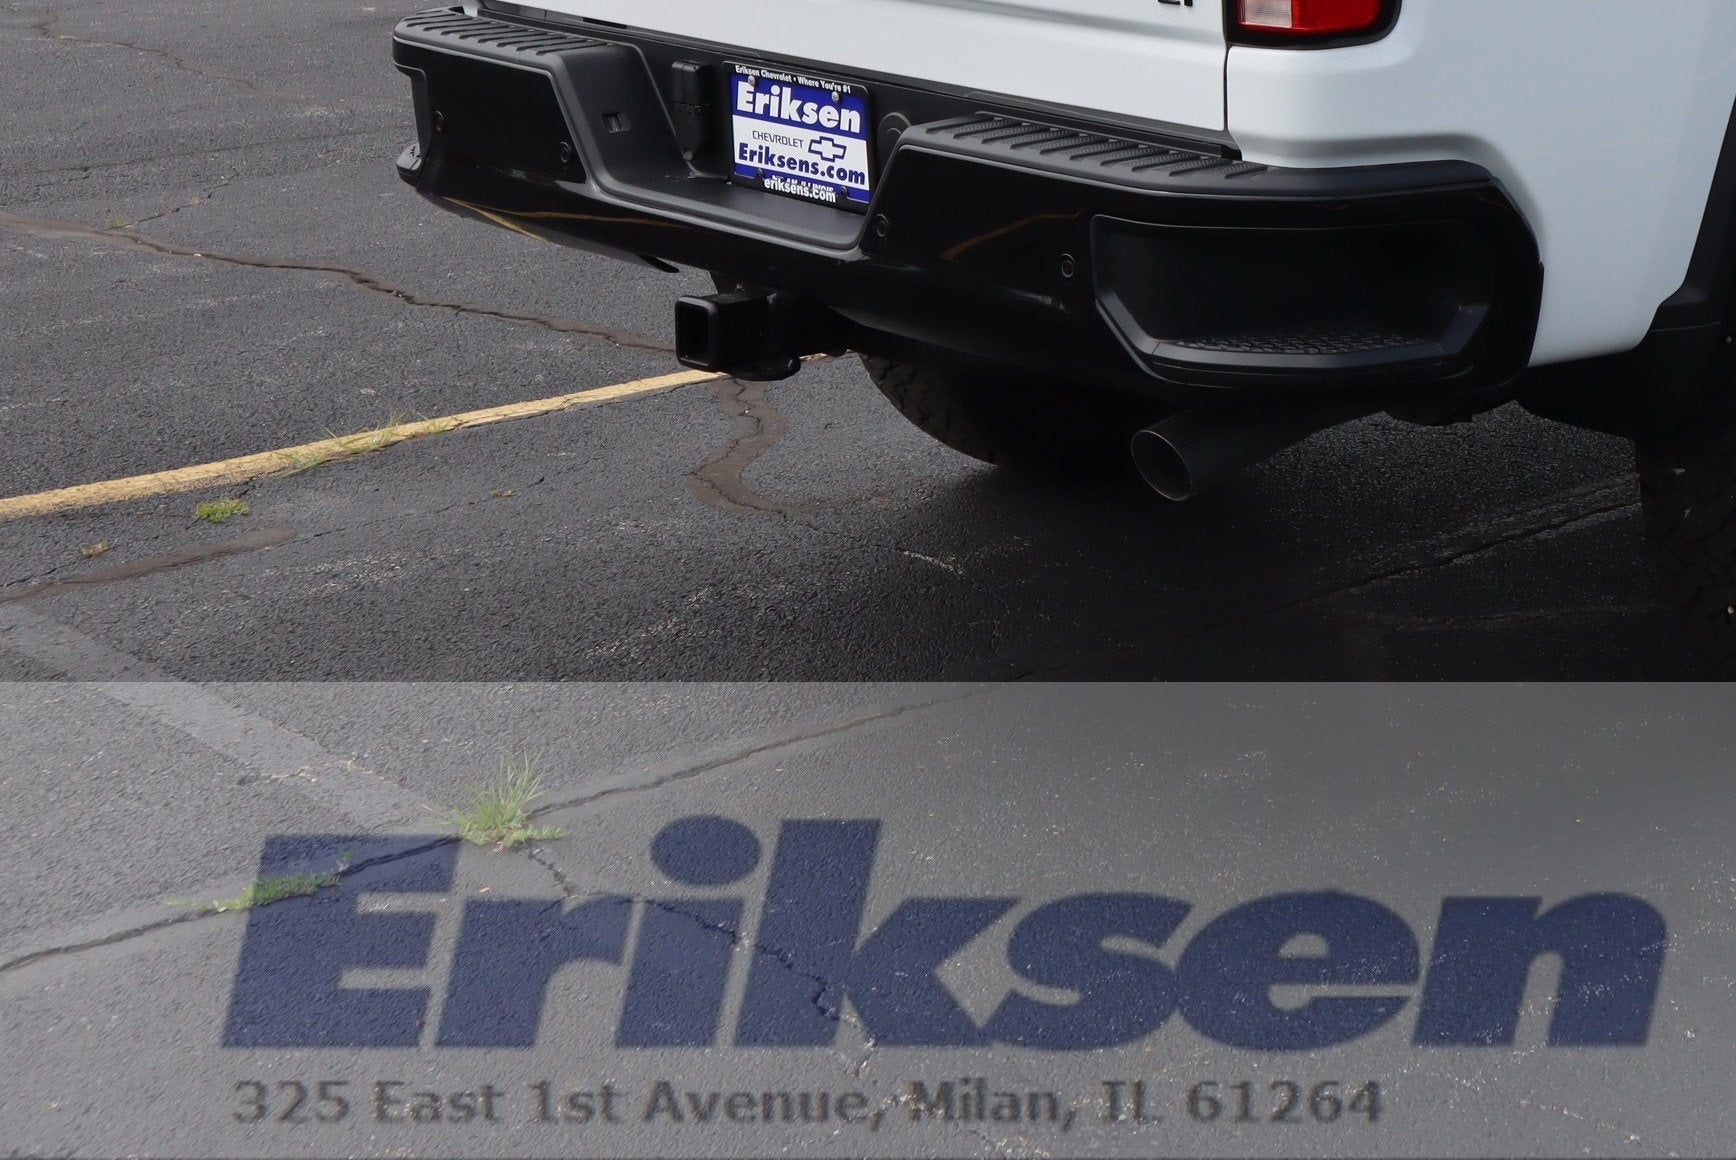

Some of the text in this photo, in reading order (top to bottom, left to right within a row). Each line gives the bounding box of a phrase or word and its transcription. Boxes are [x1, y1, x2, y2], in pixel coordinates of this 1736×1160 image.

[734, 64, 760, 76] Eriksen
[761, 69, 792, 82] Chevrolet
[797, 76, 820, 88] Where
[736, 80, 860, 134] Eriksen
[752, 130, 804, 149] CHEVROLET
[738, 142, 866, 185] Eriksens.com
[764, 178, 836, 203] eriksens.com
